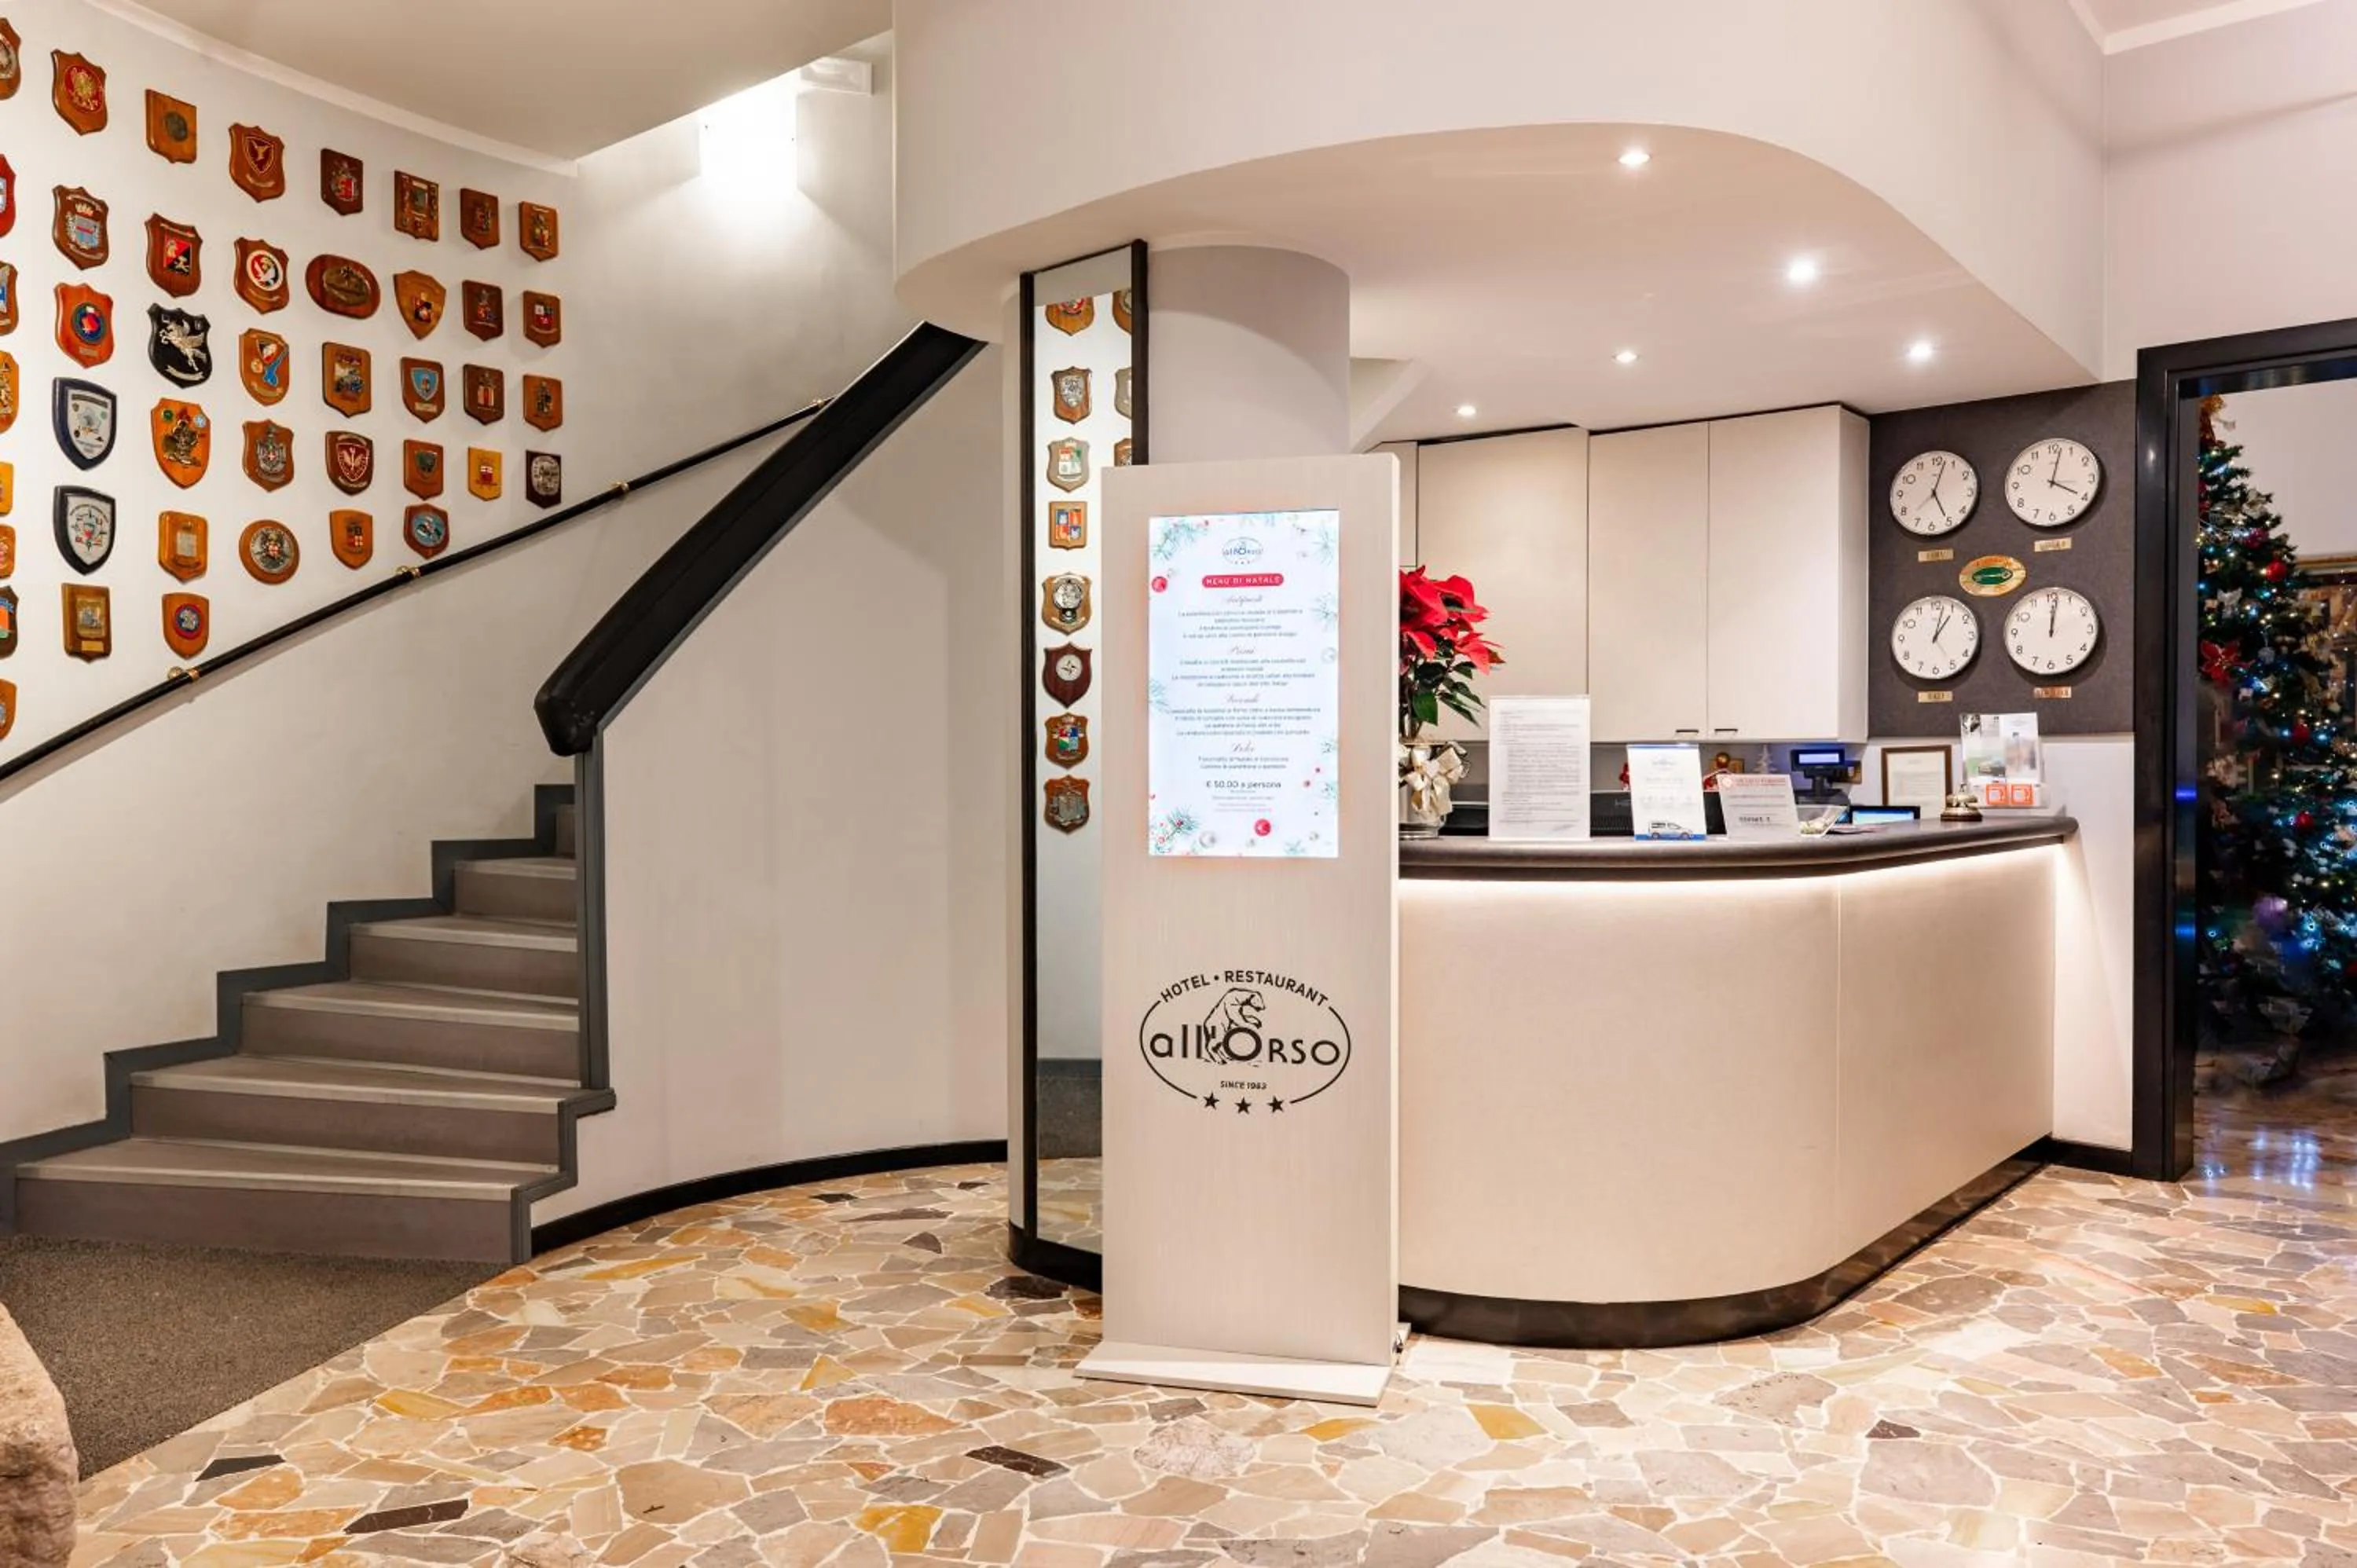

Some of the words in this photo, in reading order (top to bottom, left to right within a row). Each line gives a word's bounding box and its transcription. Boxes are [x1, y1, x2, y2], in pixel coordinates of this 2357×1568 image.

[2047, 443, 2059, 454] 12
[2069, 446, 2073, 456] 1
[2031, 451, 2039, 460] 11
[1932, 456, 1943, 466] 12
[1951, 460, 1956, 469] 1
[2081, 456, 2089, 467] 2
[1916, 462, 1924, 471] 11
[2017, 464, 2031, 475] 10
[1902, 474, 1916, 485] 10
[1962, 471, 1970, 480] 2
[2088, 473, 2095, 484] 3
[2011, 482, 2019, 492] 9
[1897, 489, 1904, 500] 9
[1967, 488, 1974, 497] 3
[2080, 493, 2088, 501] 4
[2017, 497, 2025, 507] 8
[1901, 506, 1908, 515] 8
[1959, 505, 1967, 514] 4
[2033, 508, 2040, 518] 7
[2067, 505, 2075, 515] 5
[1914, 518, 1921, 526] 7
[1945, 517, 1952, 526] 5
[2049, 512, 2056, 522] 6
[1928, 521, 1935, 531] 6
[2047, 592, 2058, 603] 12
[1930, 600, 1941, 610] 12
[2029, 599, 2037, 607] 11
[1915, 606, 1923, 615] 11
[1951, 603, 1954, 614] 1
[2080, 606, 2088, 617] 2
[1962, 614, 1970, 625] 2
[2015, 612, 2030, 622] 10
[1902, 618, 1916, 629] 10
[2011, 628, 2018, 639] 9
[2087, 624, 2094, 635] 3
[1897, 634, 1905, 644] 9
[1968, 631, 1974, 641] 3
[2015, 645, 2023, 654] 8
[2080, 643, 2088, 651] 4
[1903, 650, 1910, 661] 8
[1962, 648, 1969, 658] 4
[2032, 656, 2039, 666] 7
[2047, 660, 2055, 669] 6
[2066, 654, 2073, 665] 5
[1918, 661, 1924, 672] 7
[1949, 660, 1956, 670] 5
[1932, 666, 1940, 675] 6
[1160, 973, 1211, 1003] HOTEL
[1224, 970, 1329, 1006] RESTAURANT
[1220, 1081, 1244, 1090] SINCE
